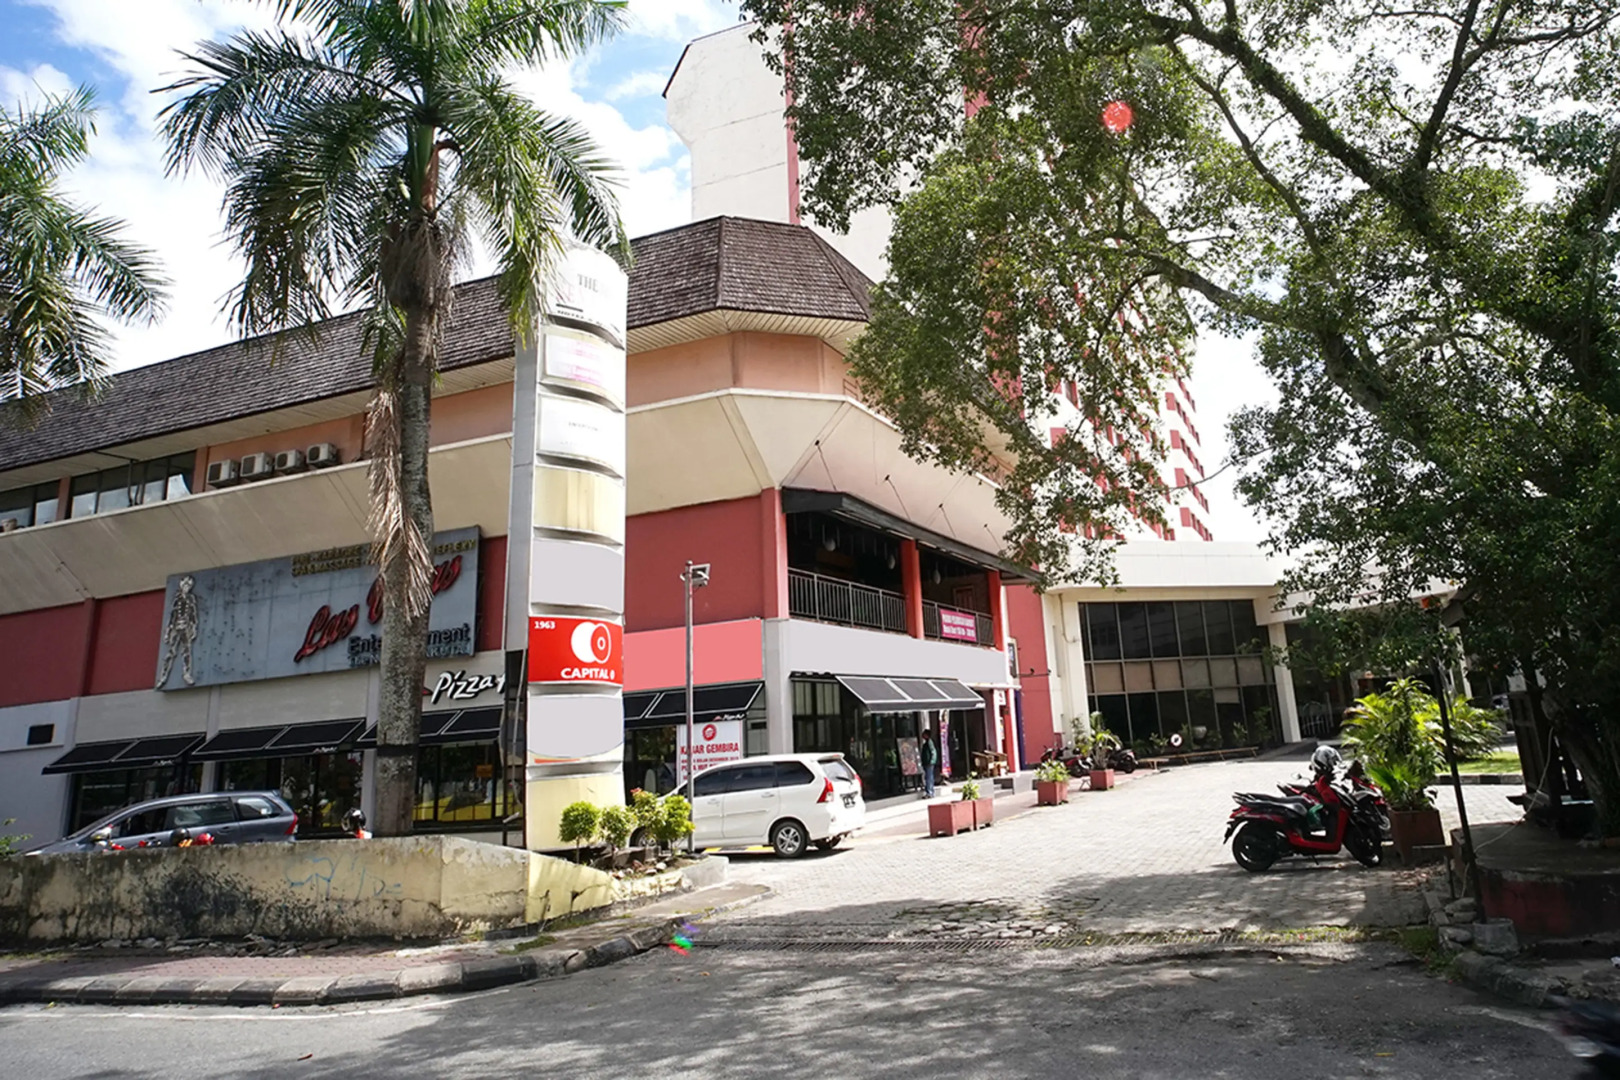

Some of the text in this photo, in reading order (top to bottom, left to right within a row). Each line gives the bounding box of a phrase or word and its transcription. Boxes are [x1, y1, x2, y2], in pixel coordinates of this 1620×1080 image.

[577, 273, 599, 293] THE
[292, 604, 358, 662] Las
[534, 621, 555, 629] 1963
[346, 622, 470, 655] Entement
[560, 667, 609, 679] CAPITAL
[431, 670, 493, 704] Pizza
[706, 742, 739, 753] GEMBIRA
